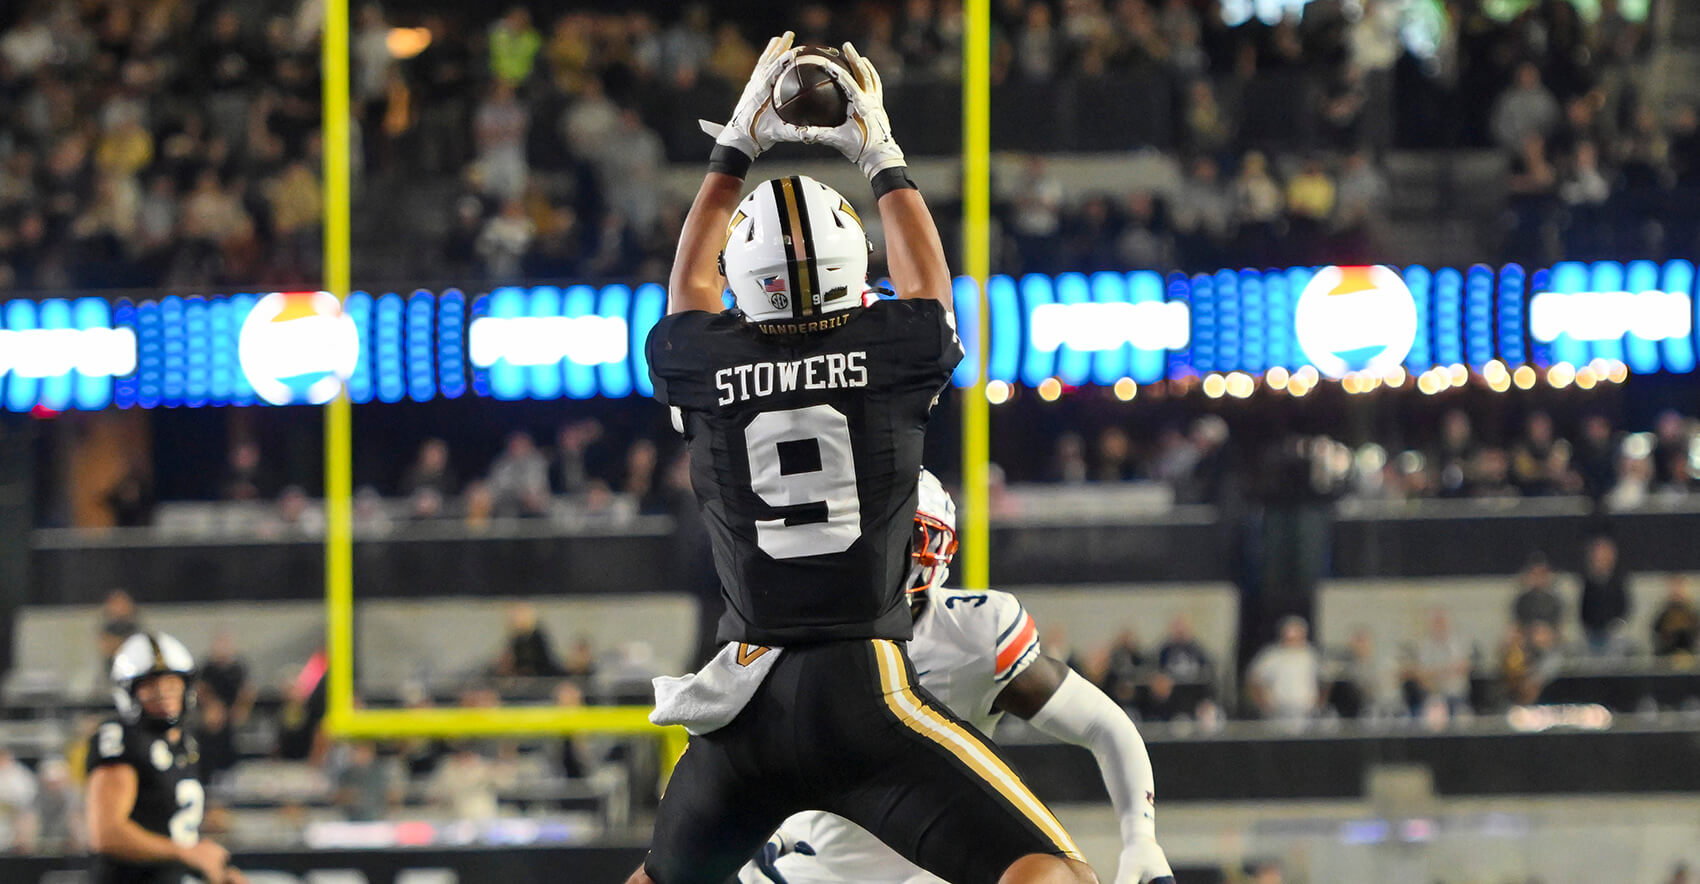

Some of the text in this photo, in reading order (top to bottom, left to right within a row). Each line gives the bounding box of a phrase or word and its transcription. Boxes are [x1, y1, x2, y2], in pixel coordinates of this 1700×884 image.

[812, 294, 821, 306] 9
[759, 314, 850, 335] VANDERBILT
[715, 351, 869, 406] STOWERS
[744, 404, 862, 560] 9
[98, 721, 125, 758] 2
[169, 778, 205, 849] 2
